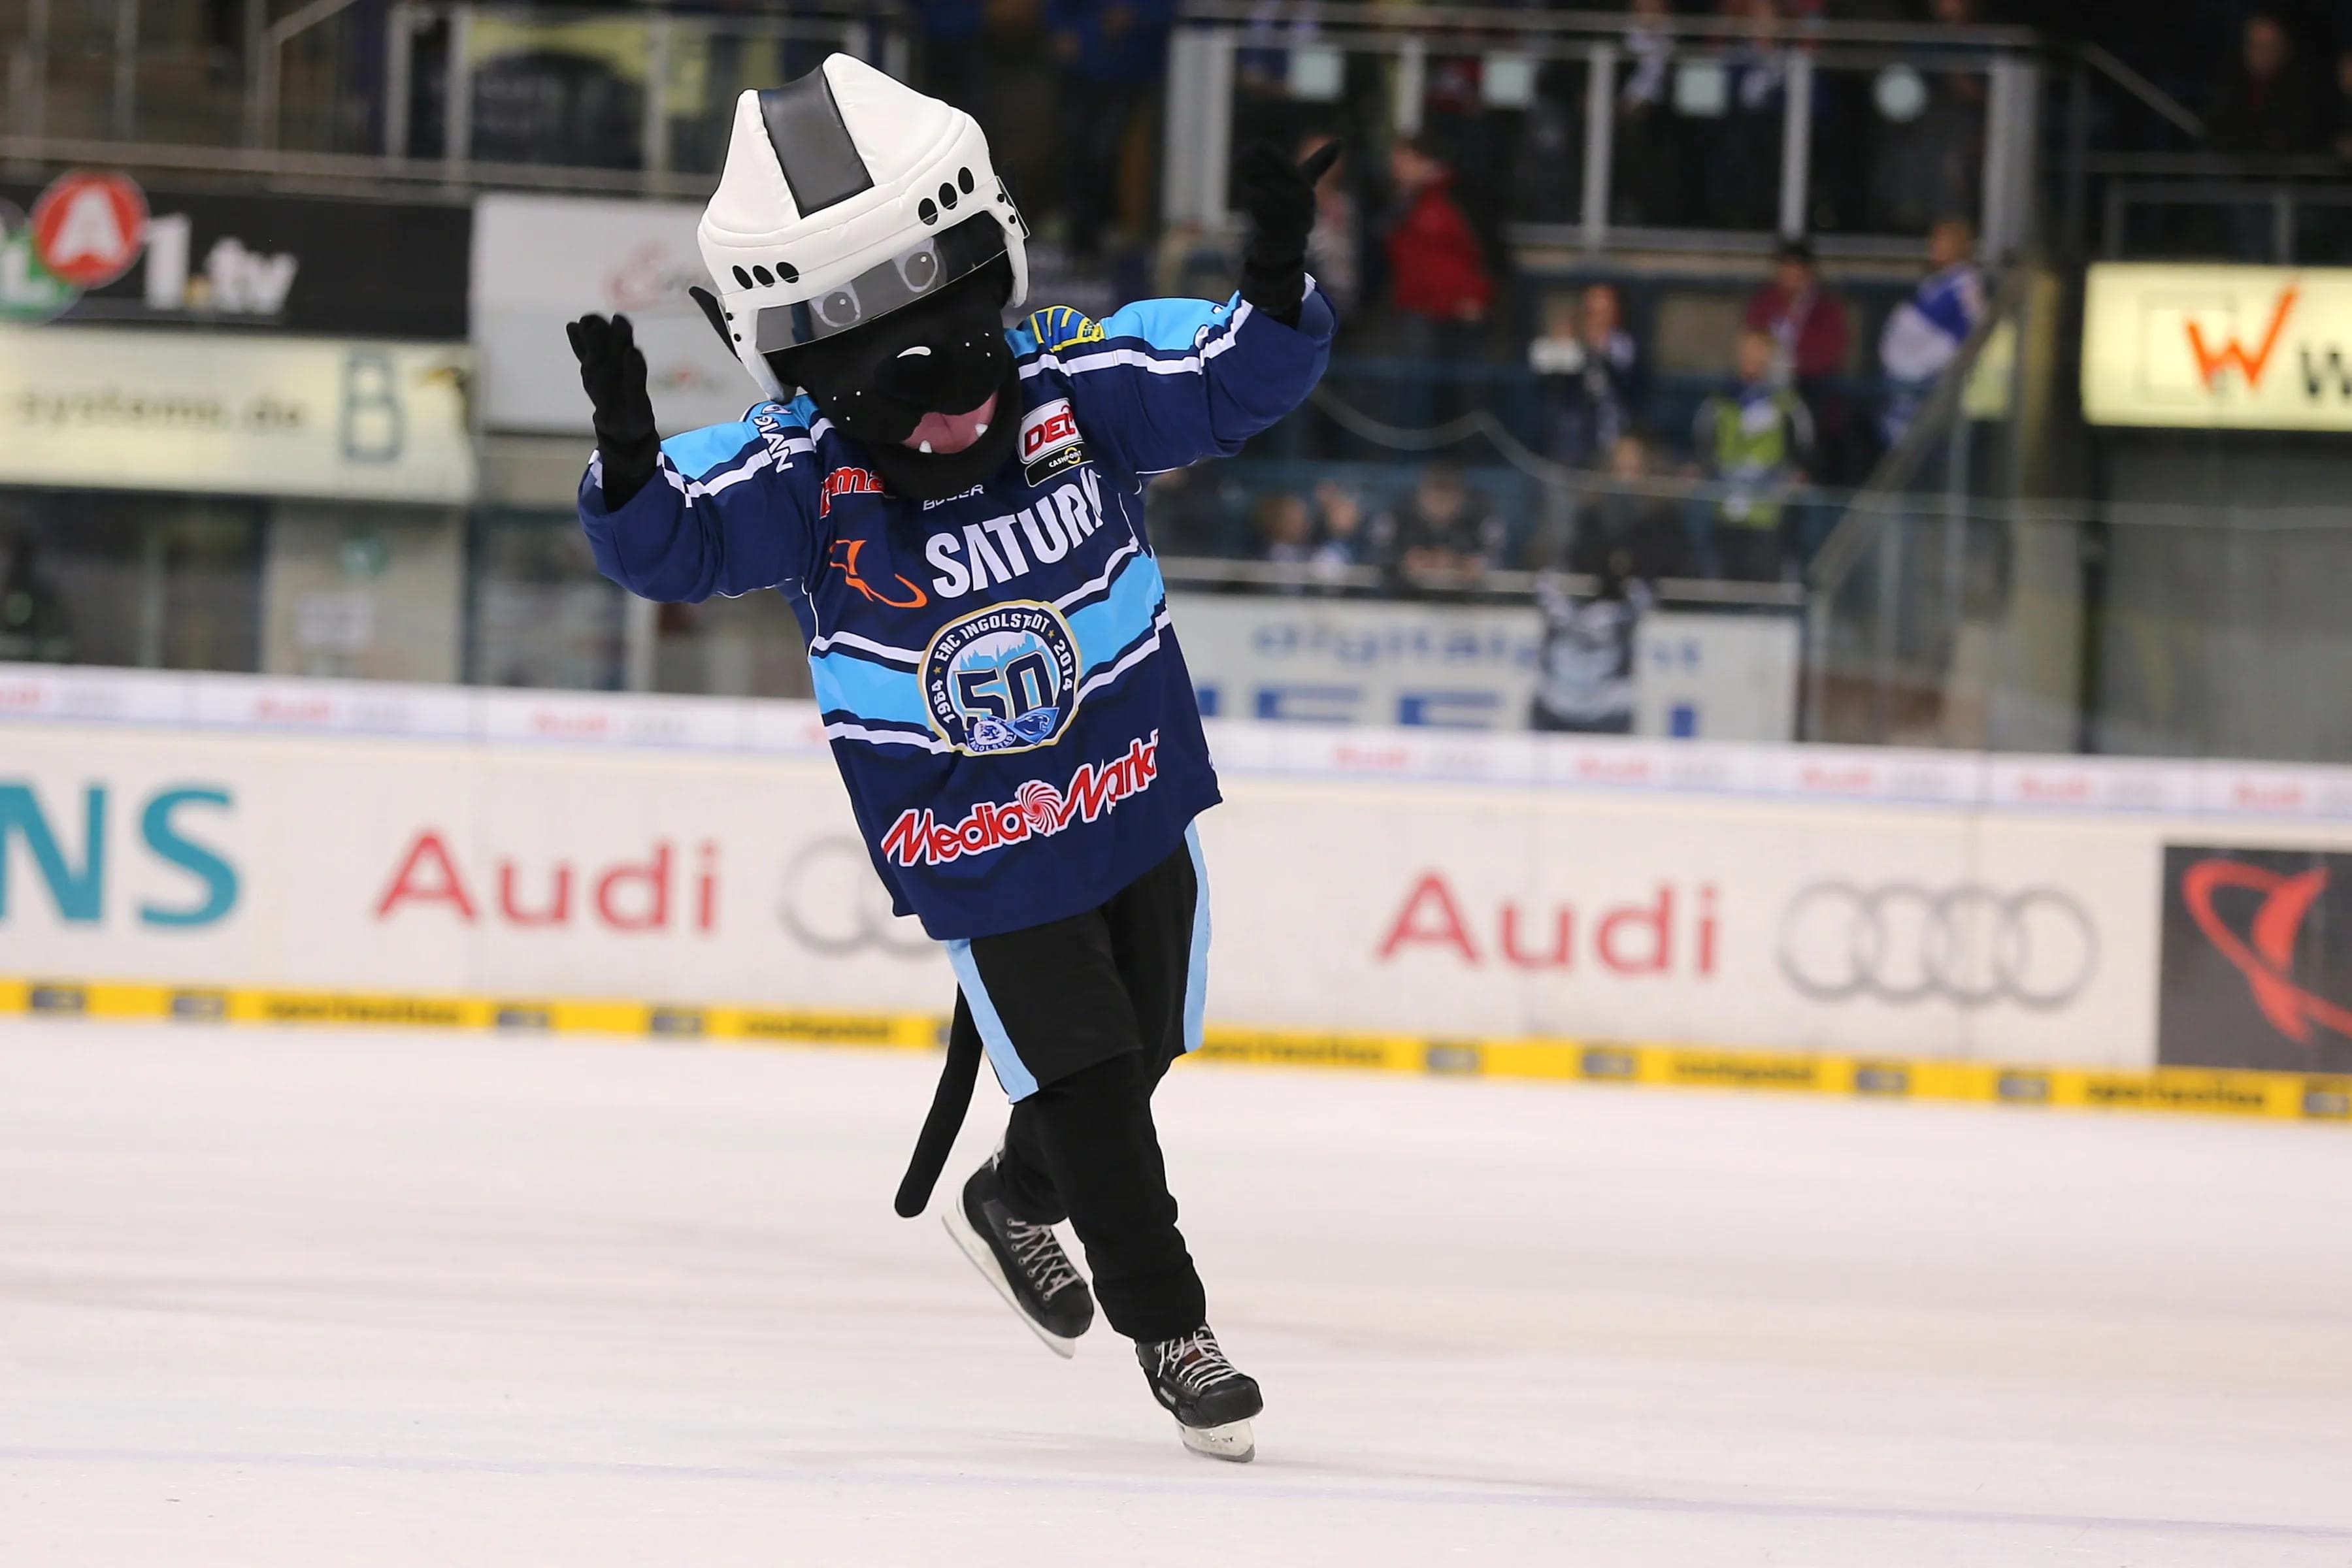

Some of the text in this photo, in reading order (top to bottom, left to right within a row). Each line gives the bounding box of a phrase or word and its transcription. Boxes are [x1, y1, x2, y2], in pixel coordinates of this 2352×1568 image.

[1025, 412, 1076, 457] DEL
[923, 483, 984, 511] BER
[934, 634, 961, 662] ERC
[1053, 638, 1074, 691] 2014
[931, 679, 956, 725] 1964
[953, 650, 1056, 731] 50
[0, 782, 240, 926] NS
[374, 827, 720, 934] Audi
[1376, 868, 1720, 979] Audi
